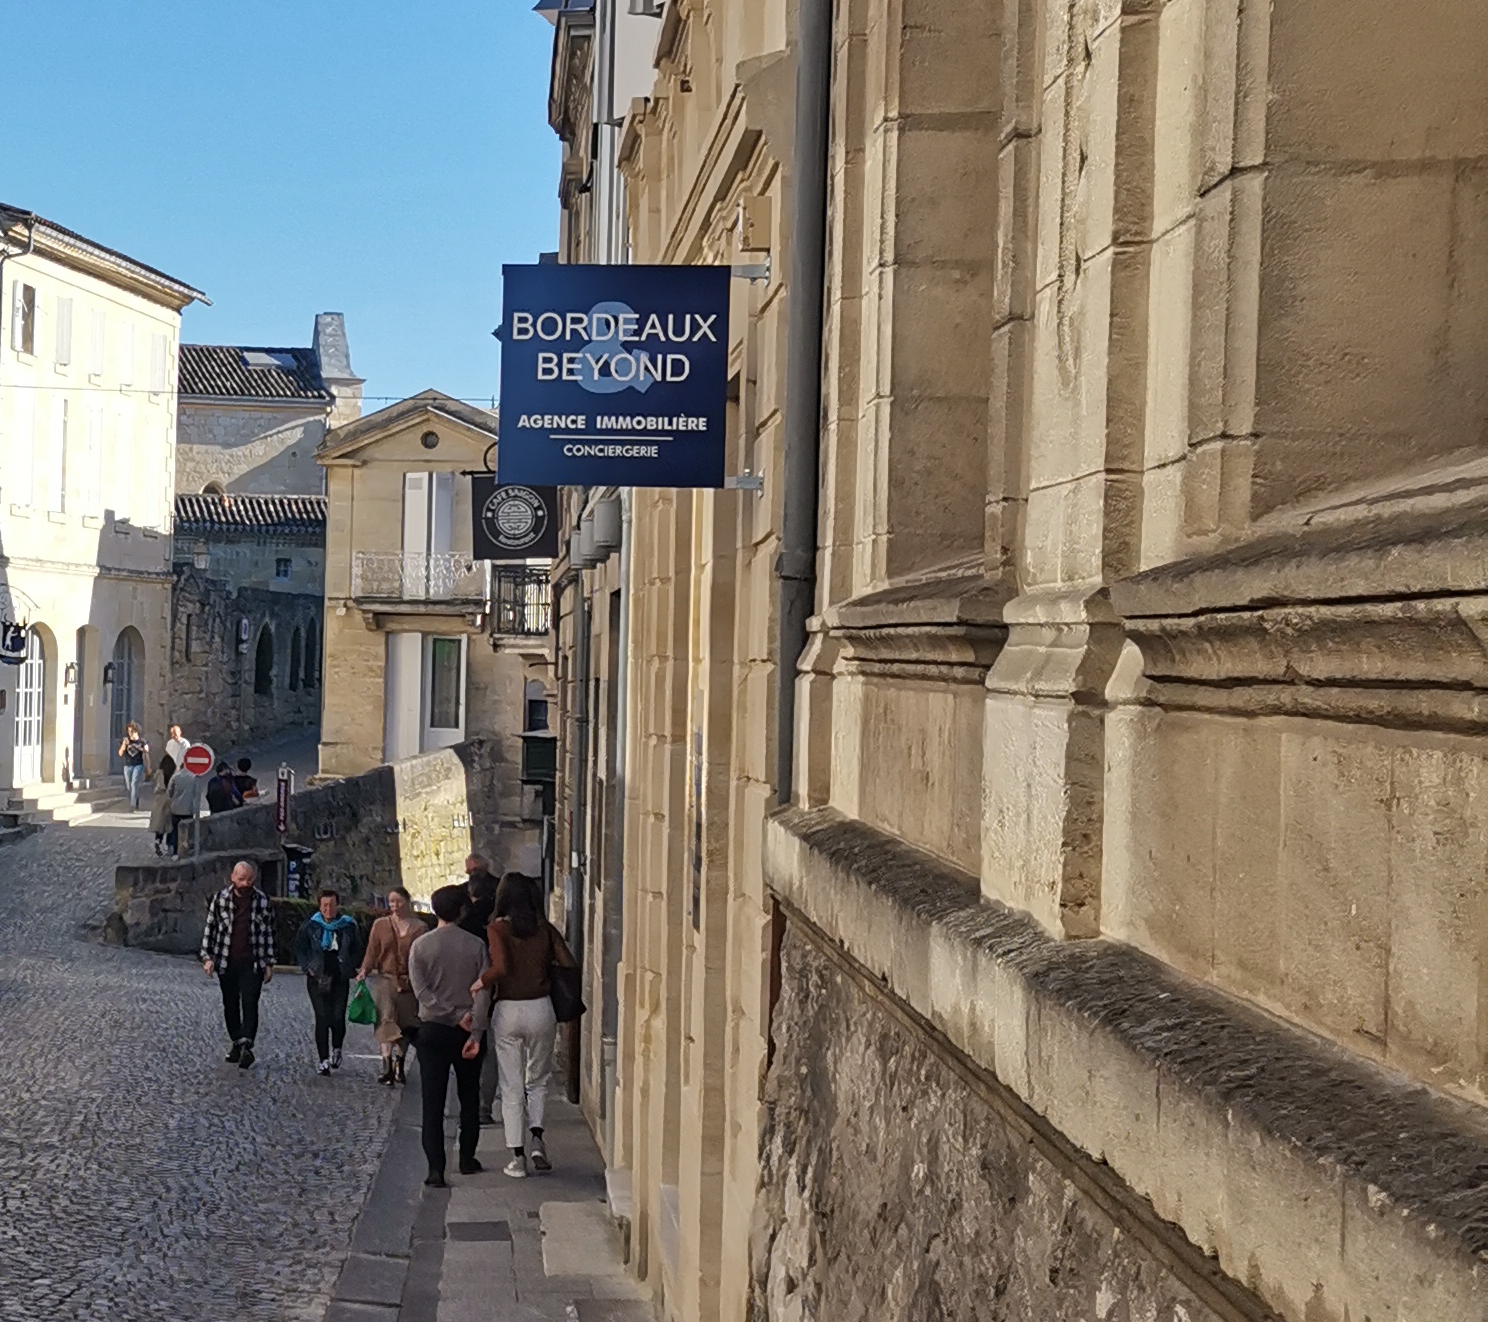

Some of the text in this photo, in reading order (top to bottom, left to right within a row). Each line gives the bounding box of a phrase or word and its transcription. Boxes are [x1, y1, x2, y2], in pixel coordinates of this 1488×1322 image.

[512, 312, 718, 342] BORDEAUX
[537, 352, 690, 382] BEYOND
[517, 413, 707, 431] AGENCE IMMOBILIÈRE
[563, 444, 659, 458] CONCIERGERIE
[508, 488, 541, 508] SAIGON
